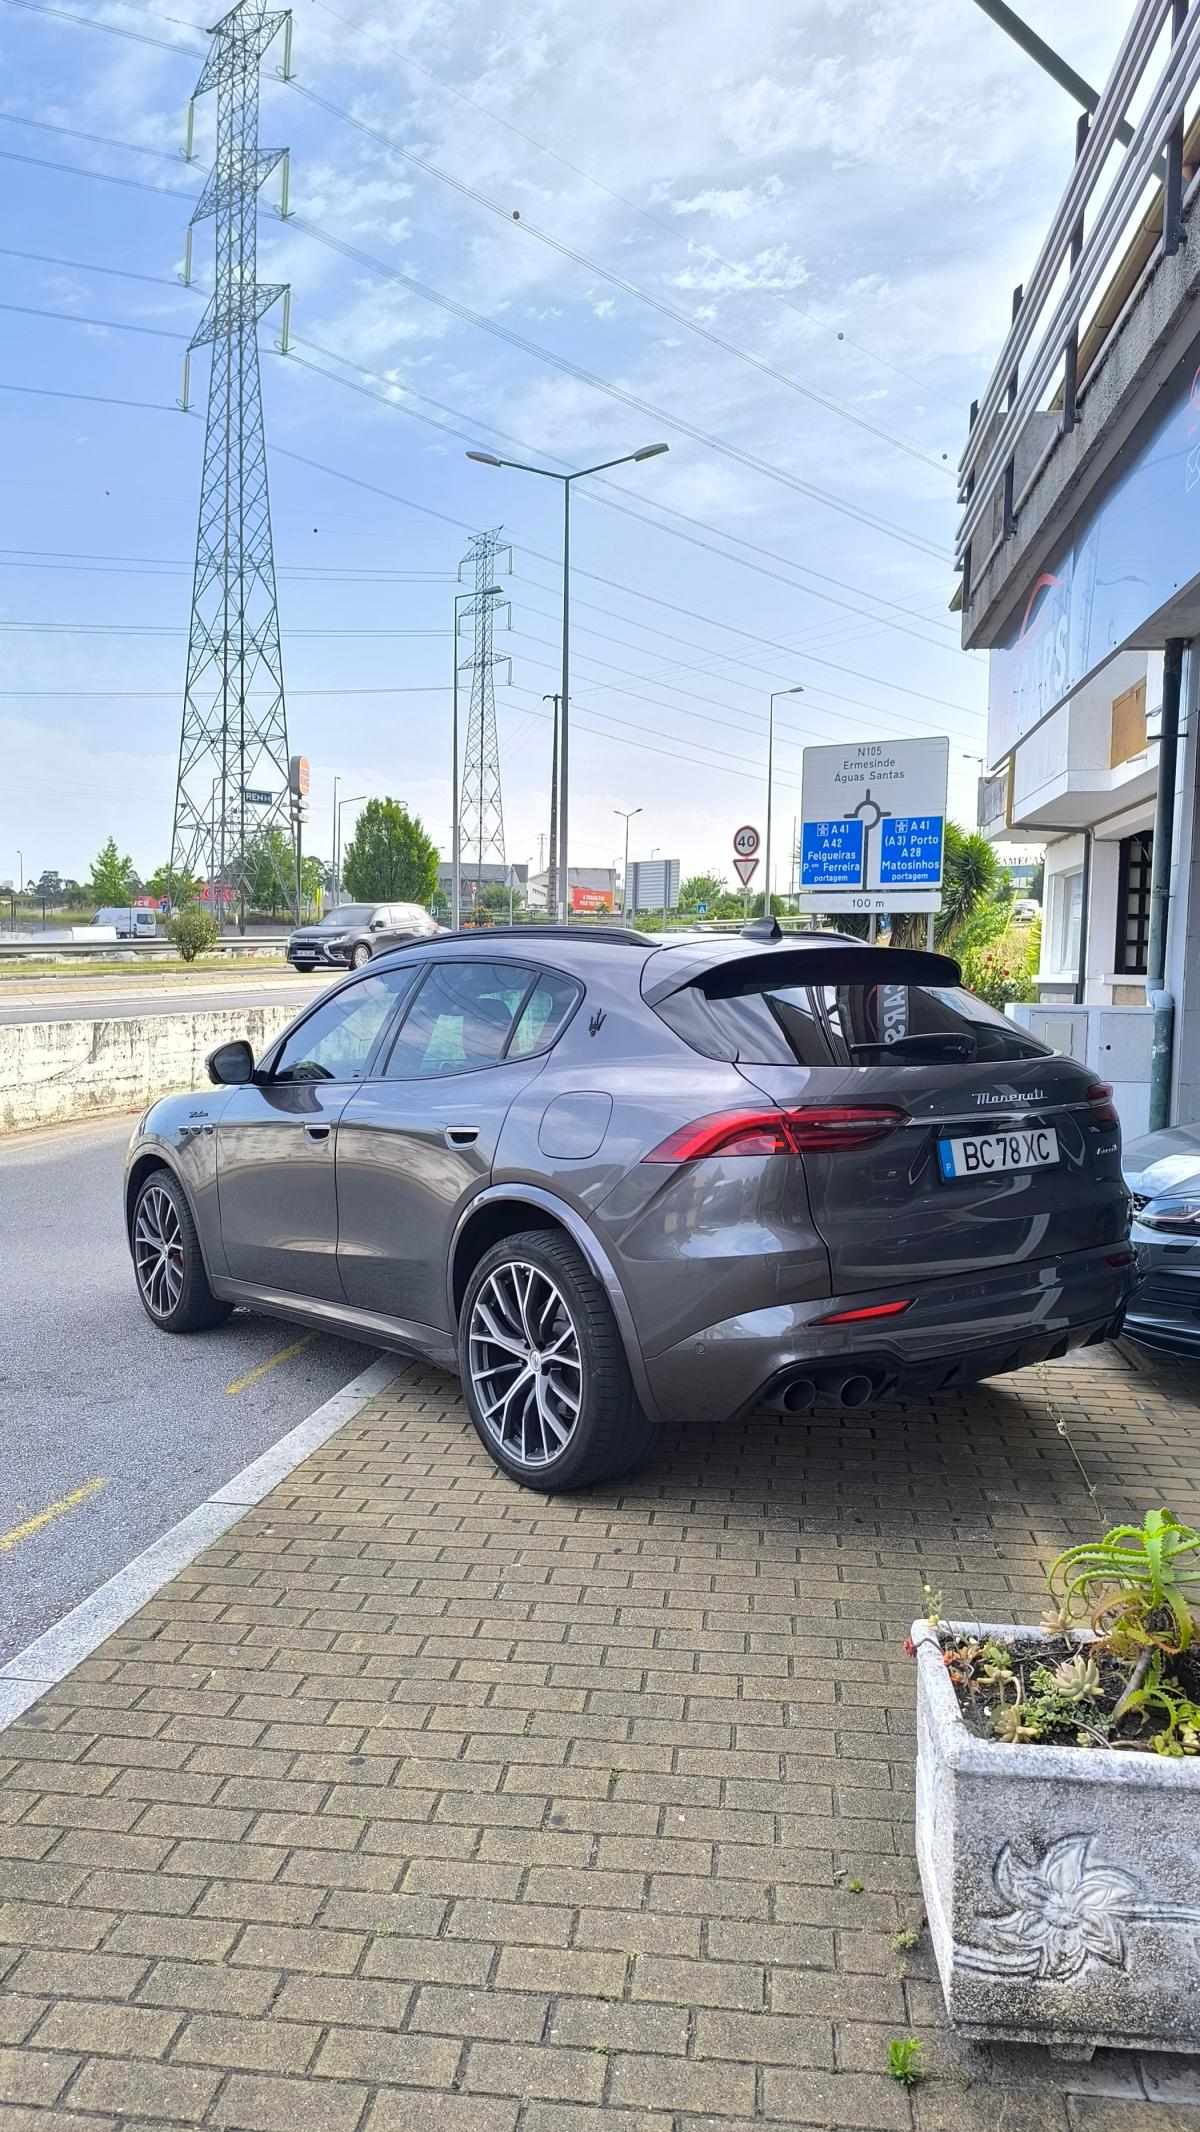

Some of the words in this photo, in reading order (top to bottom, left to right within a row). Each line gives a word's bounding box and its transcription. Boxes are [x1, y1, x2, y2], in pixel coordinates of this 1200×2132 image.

[857, 745, 882, 757] N105
[843, 757, 896, 770] Ermesinde
[869, 770, 905, 781] Santas
[738, 835, 755, 848] 40
[910, 835, 939, 845] Porto
[807, 850, 856, 862] Felgueiras
[823, 862, 860, 872] Ferreira
[881, 859, 940, 870] Matosinhos
[814, 873, 848, 883] portagem
[891, 871, 929, 881] portagem
[852, 899, 871, 908] 100
[875, 899, 885, 908] m
[971, 1088, 1048, 1105] Maserati
